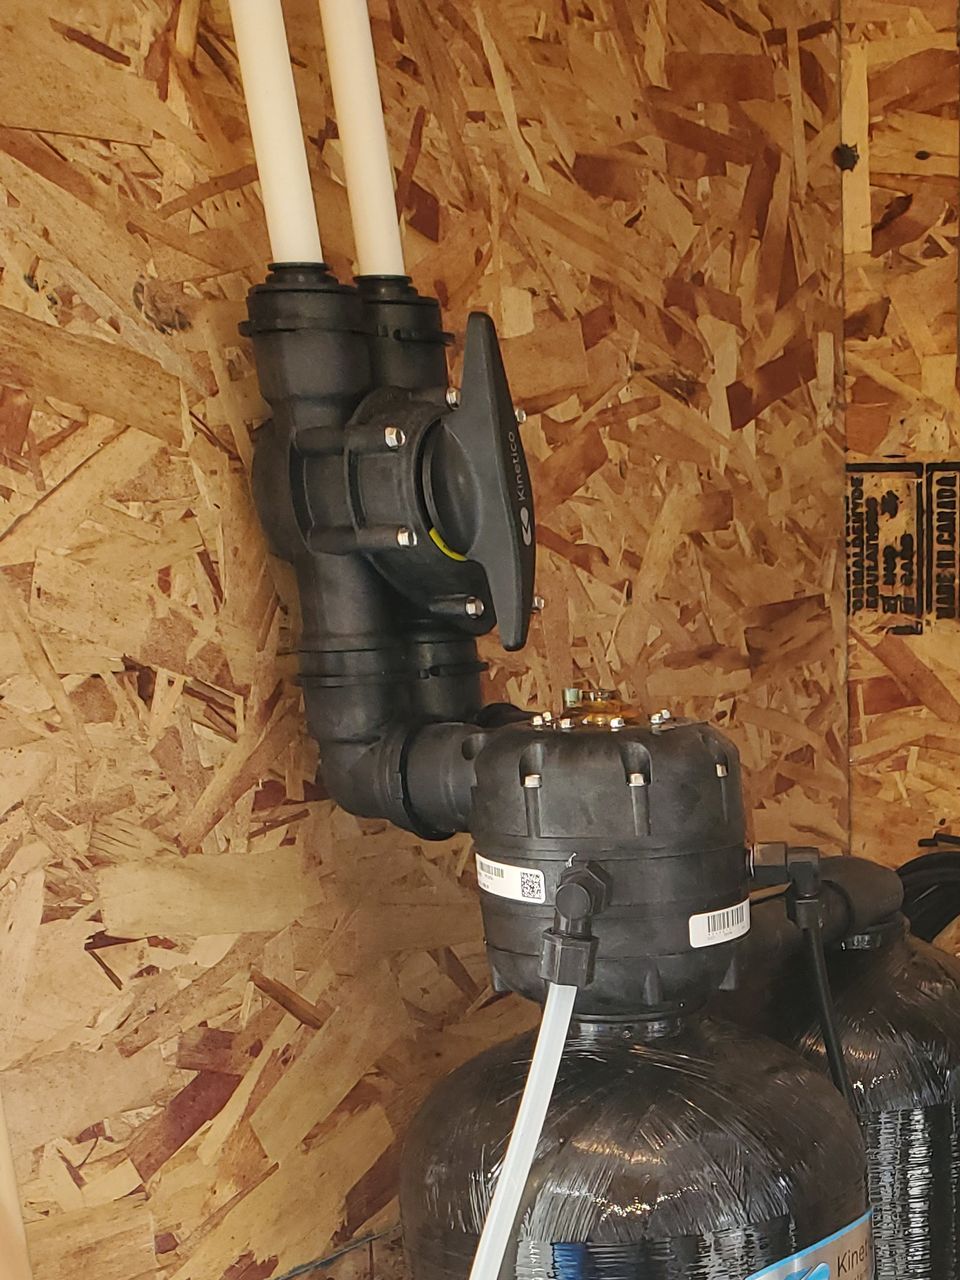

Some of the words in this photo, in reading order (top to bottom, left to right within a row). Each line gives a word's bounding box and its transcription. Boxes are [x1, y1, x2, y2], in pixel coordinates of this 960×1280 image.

[508, 431, 526, 501] Kinetico
[851, 476, 864, 615] ORMALDEHYDE
[937, 473, 957, 547] CANADA
